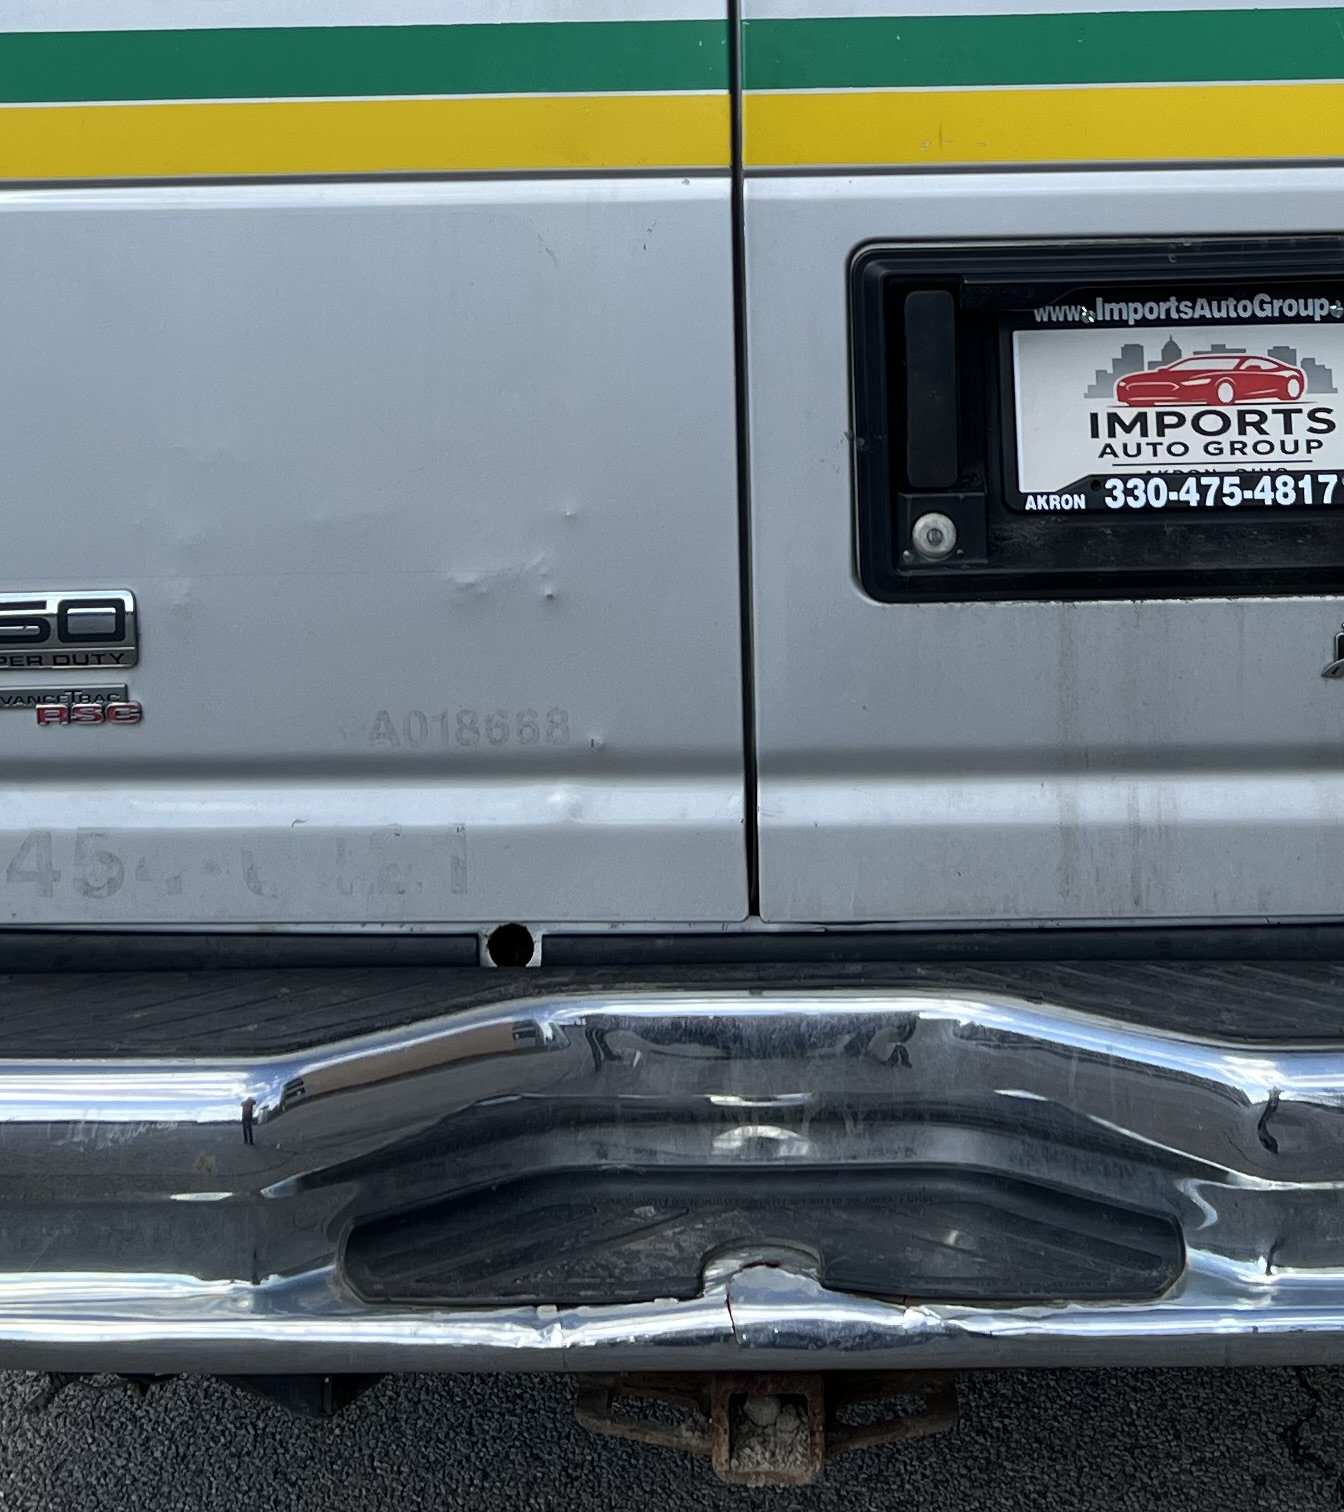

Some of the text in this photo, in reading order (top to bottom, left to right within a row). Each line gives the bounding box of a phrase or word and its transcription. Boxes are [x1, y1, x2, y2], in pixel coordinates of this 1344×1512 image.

[1089, 406, 1337, 439] IMPORTS
[1098, 439, 1324, 458] AUTO GROUP
[1025, 492, 1086, 511] AKRON
[1105, 474, 1338, 508] 330-475-4817
[53, 652, 125, 667] DUTY
[36, 702, 143, 726] RSC
